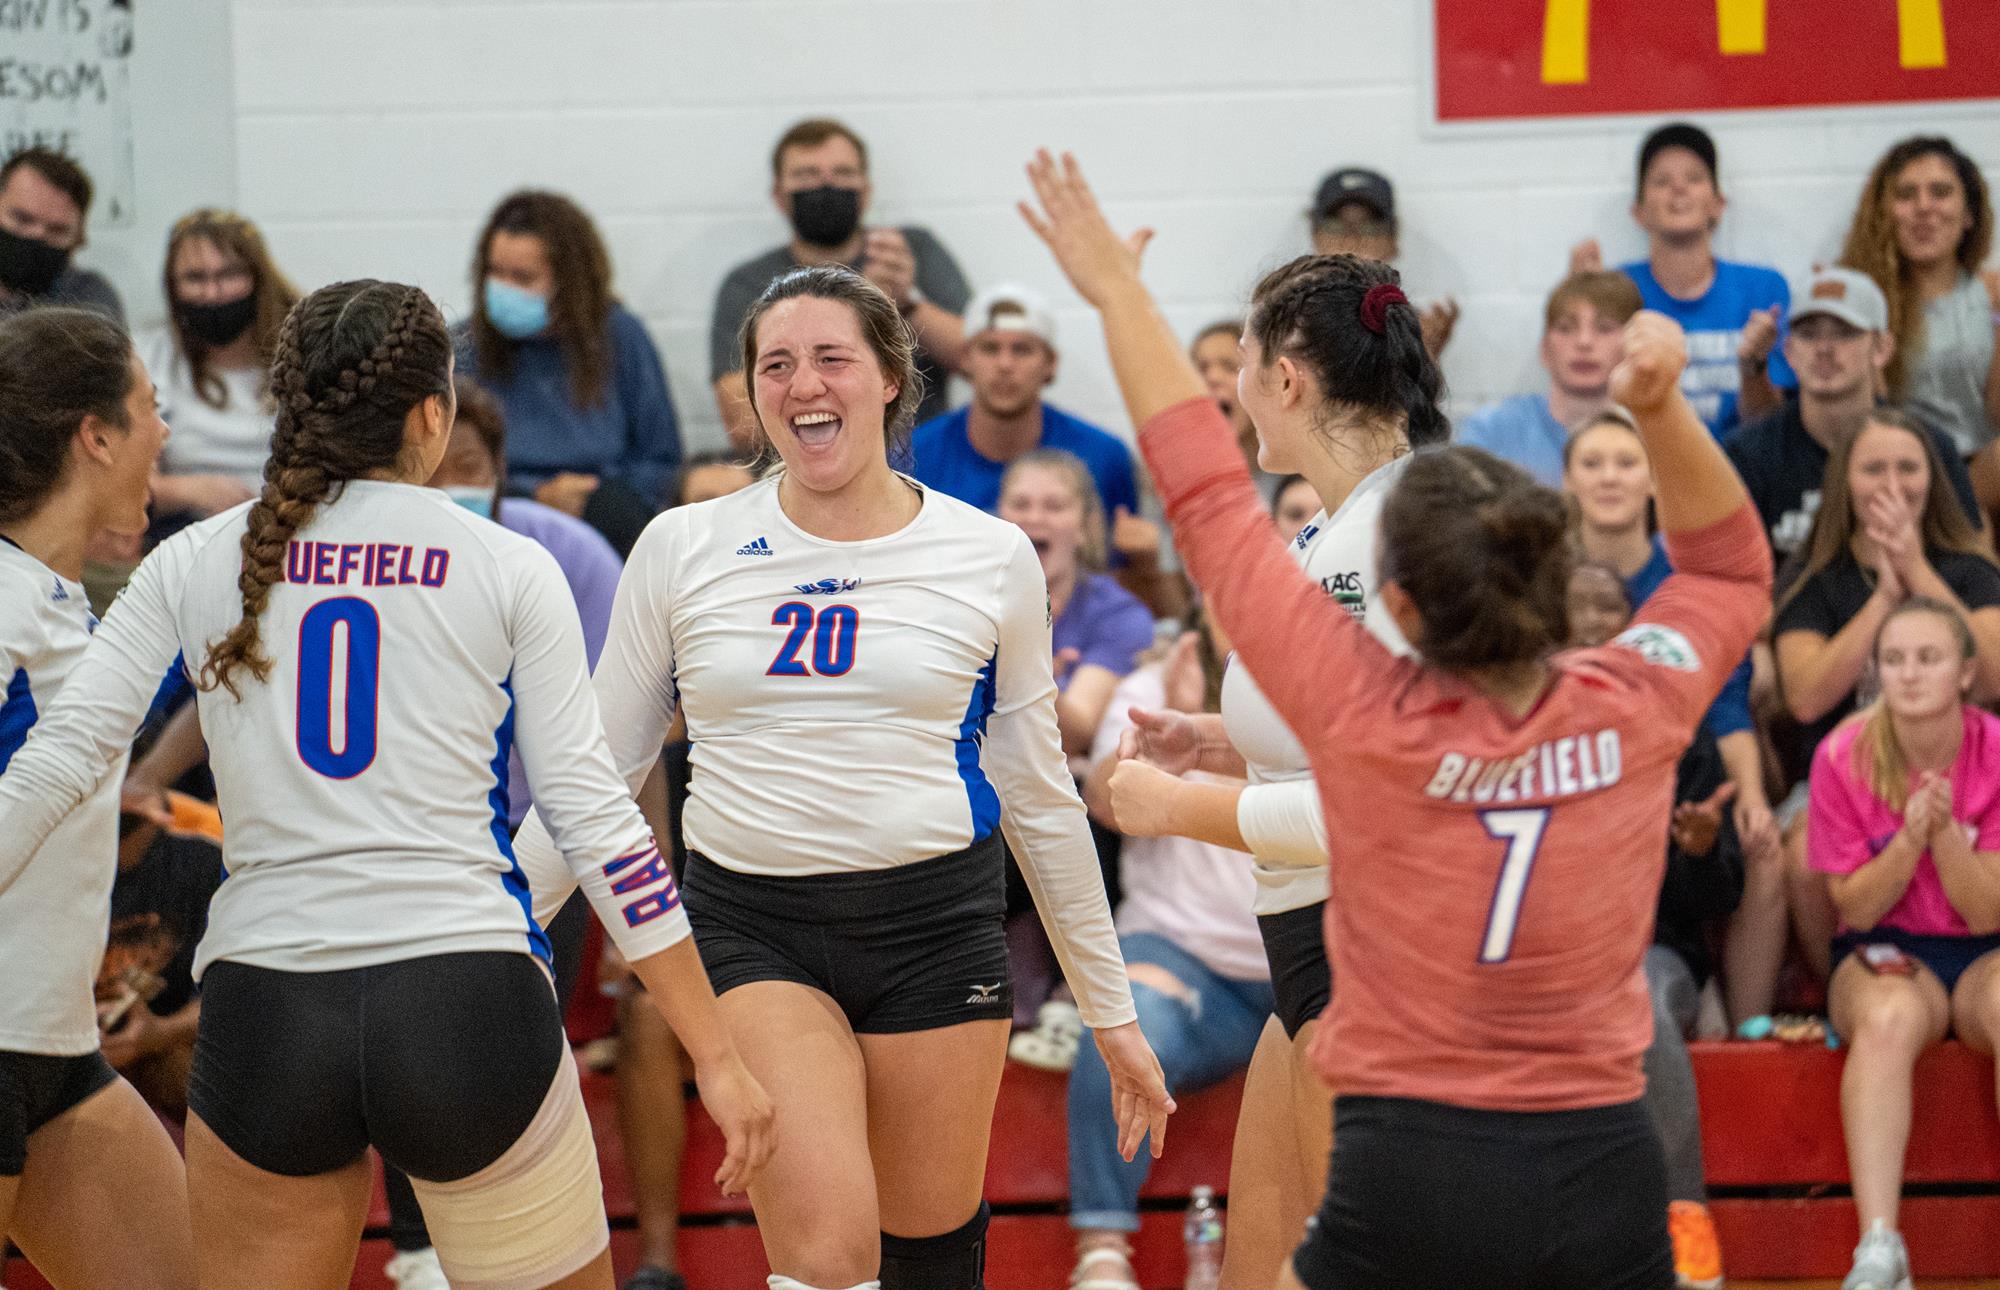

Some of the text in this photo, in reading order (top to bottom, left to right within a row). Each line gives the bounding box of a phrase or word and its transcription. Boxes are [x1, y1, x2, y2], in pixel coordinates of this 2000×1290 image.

[274, 540, 450, 588] UEFIELD
[736, 547, 774, 556] adidas
[765, 601, 860, 678] 20
[296, 596, 381, 780] 0
[1424, 728, 1622, 804] BLUEFIELD
[1477, 805, 1554, 965] 7
